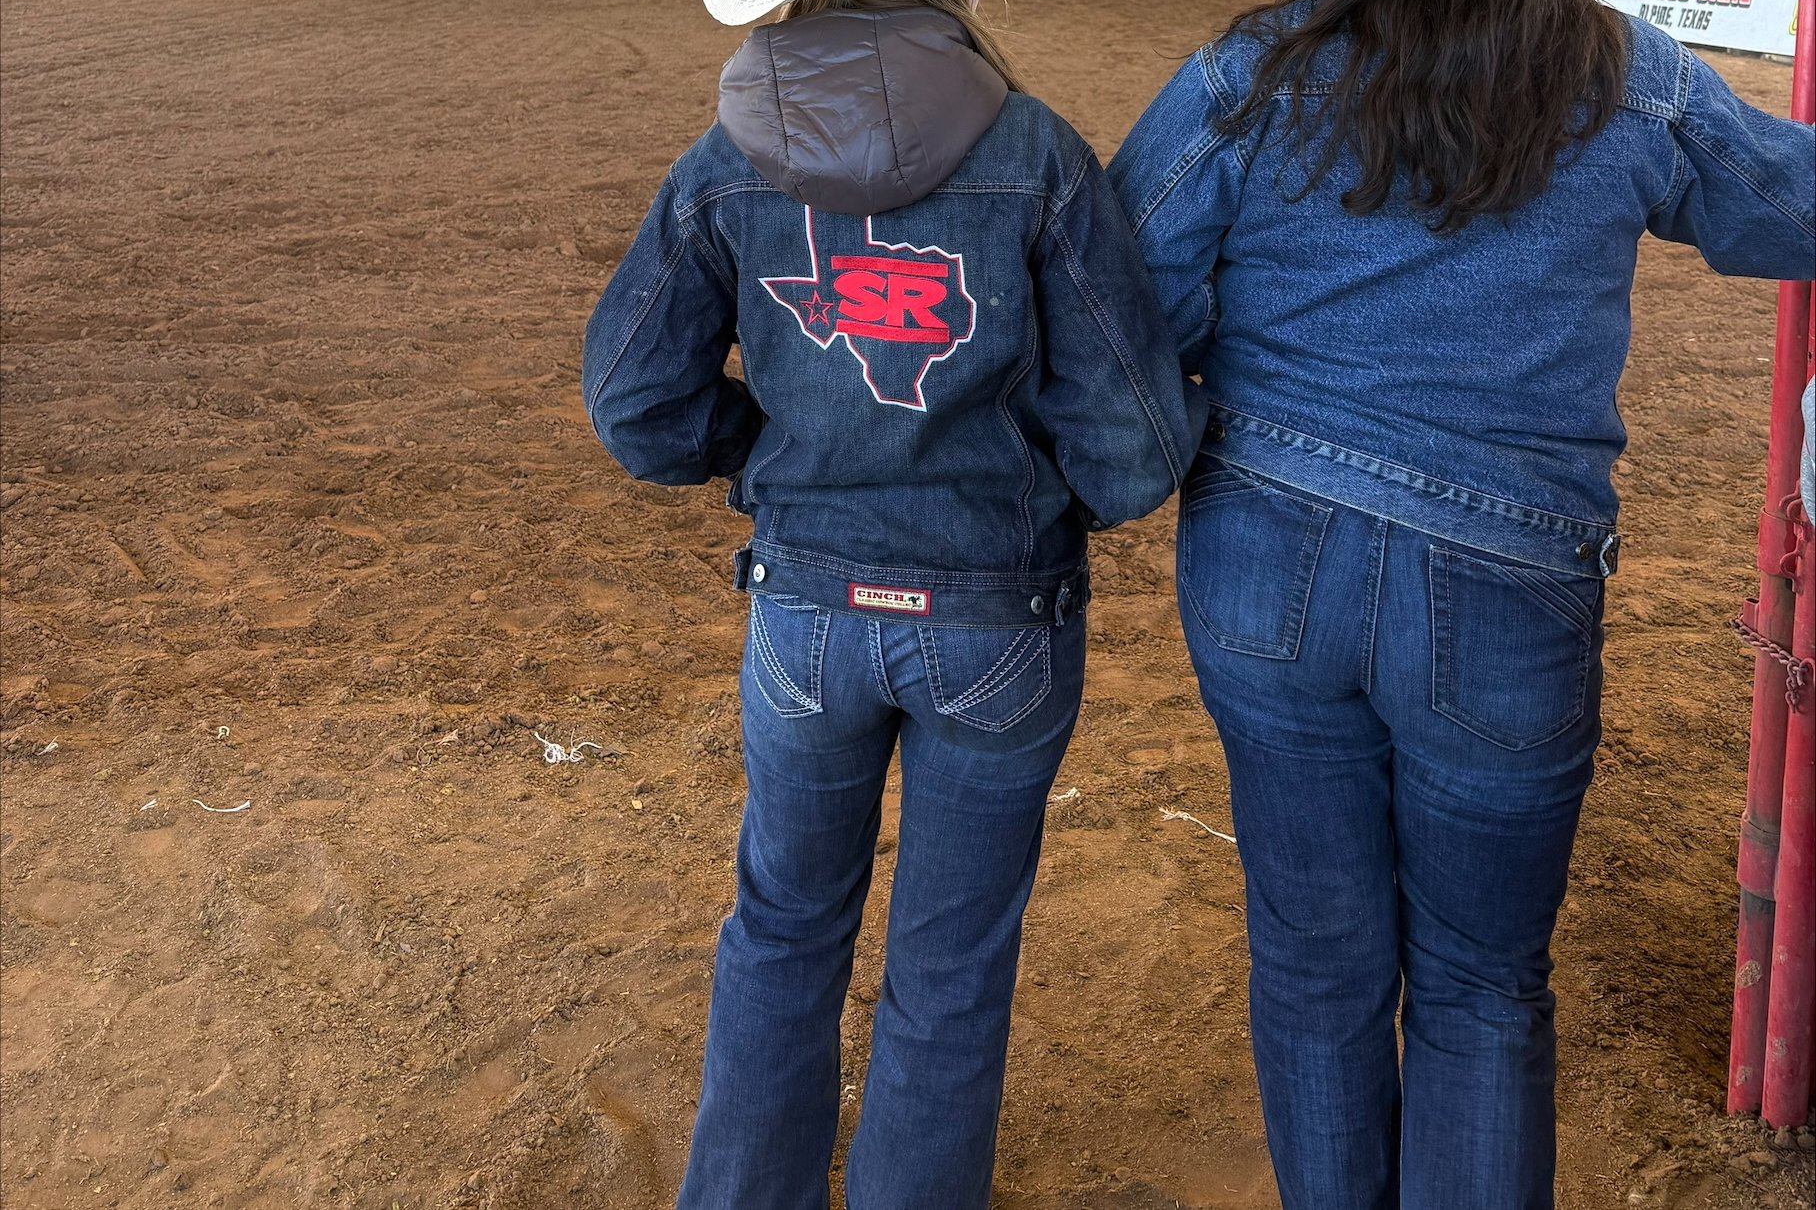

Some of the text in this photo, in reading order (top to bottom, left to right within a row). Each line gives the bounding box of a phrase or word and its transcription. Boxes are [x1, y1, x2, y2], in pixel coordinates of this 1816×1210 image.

[1639, 3, 1713, 31] ALPINE, TEXAS
[833, 270, 949, 329] SR
[856, 590, 905, 602] CINCH
